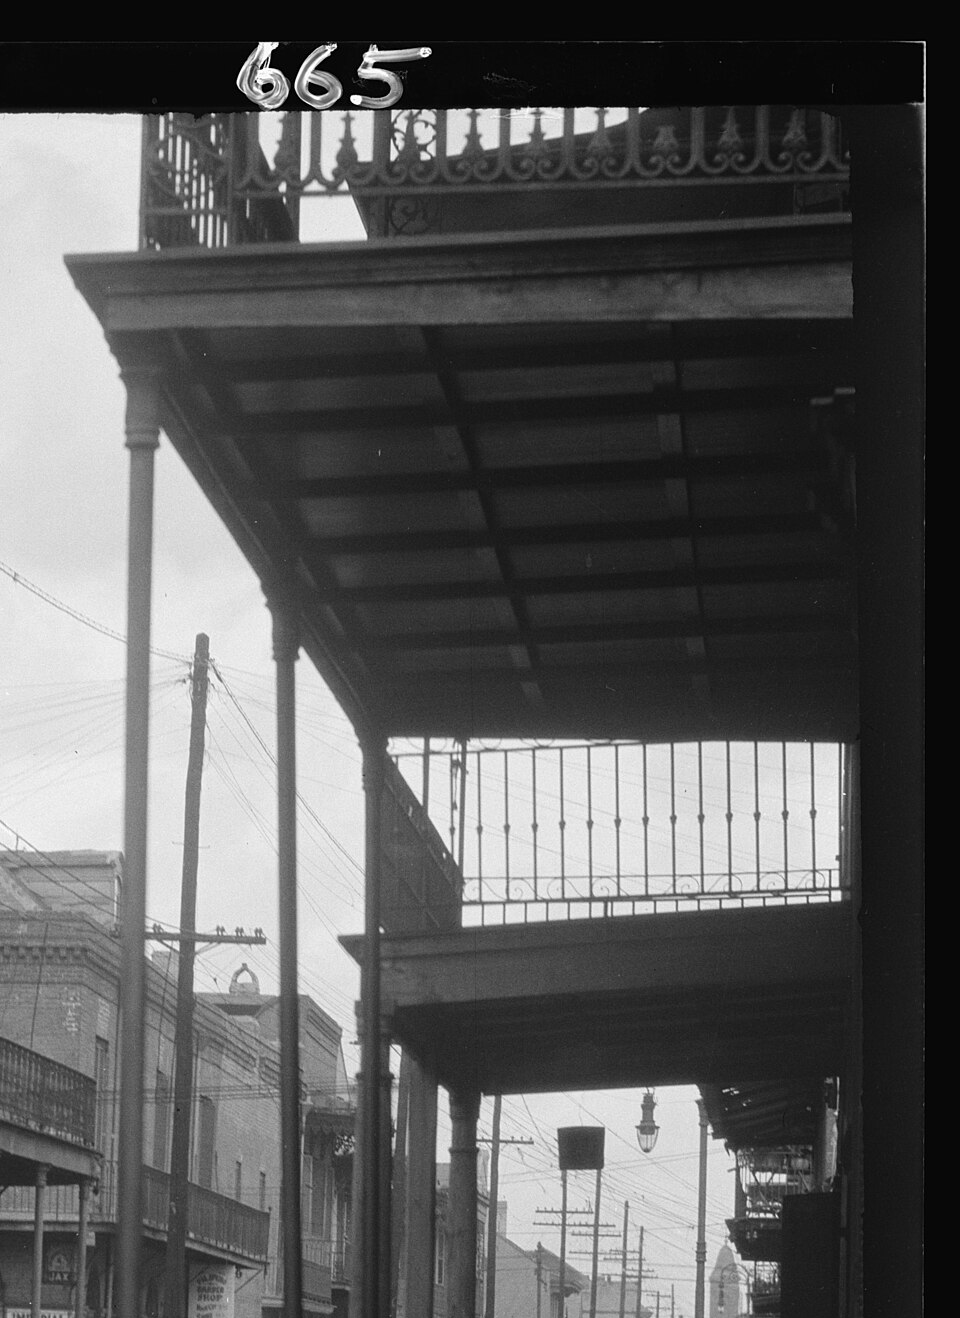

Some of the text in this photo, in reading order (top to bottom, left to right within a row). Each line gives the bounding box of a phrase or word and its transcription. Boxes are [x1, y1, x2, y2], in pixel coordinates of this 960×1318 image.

[236, 42, 433, 110] 665
[48, 1273, 69, 1281] JAX
[197, 1294, 223, 1302] SHOP
